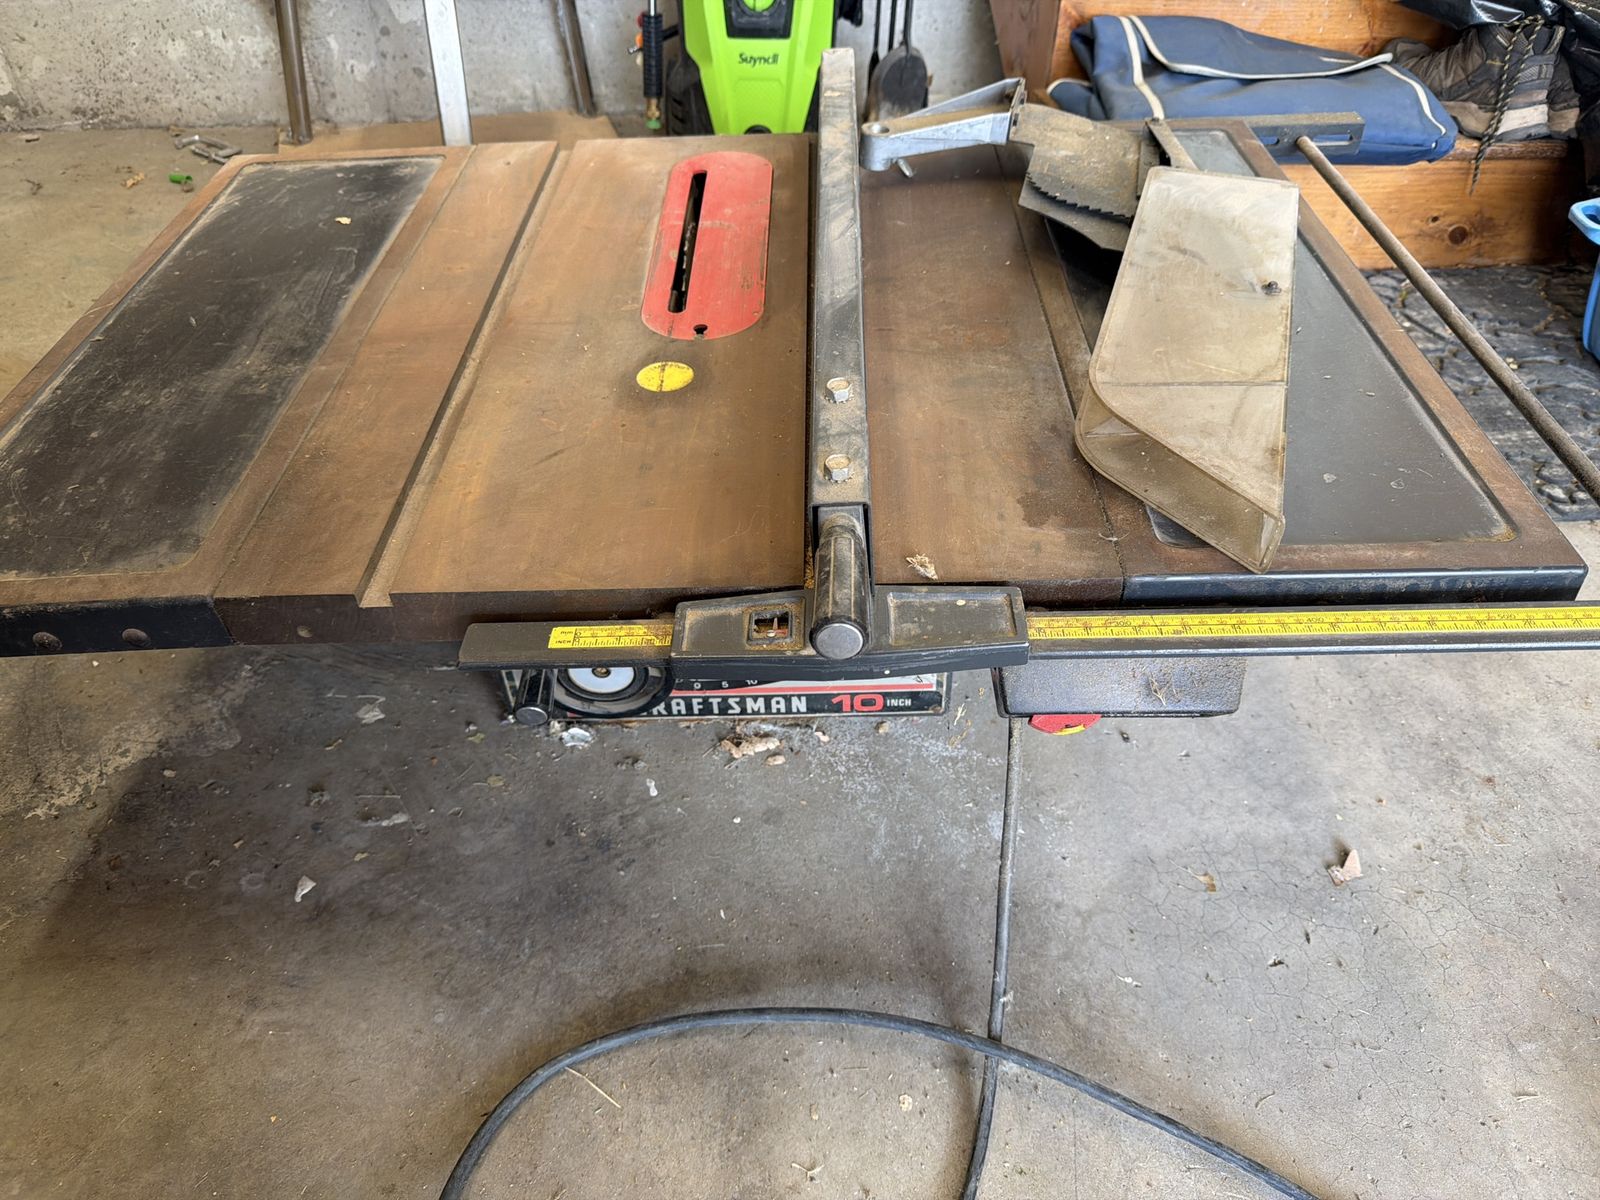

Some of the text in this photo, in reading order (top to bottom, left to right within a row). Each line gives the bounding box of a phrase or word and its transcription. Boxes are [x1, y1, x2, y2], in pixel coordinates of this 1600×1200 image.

[640, 693, 912, 716] RAFTSMAN 10 INCH
